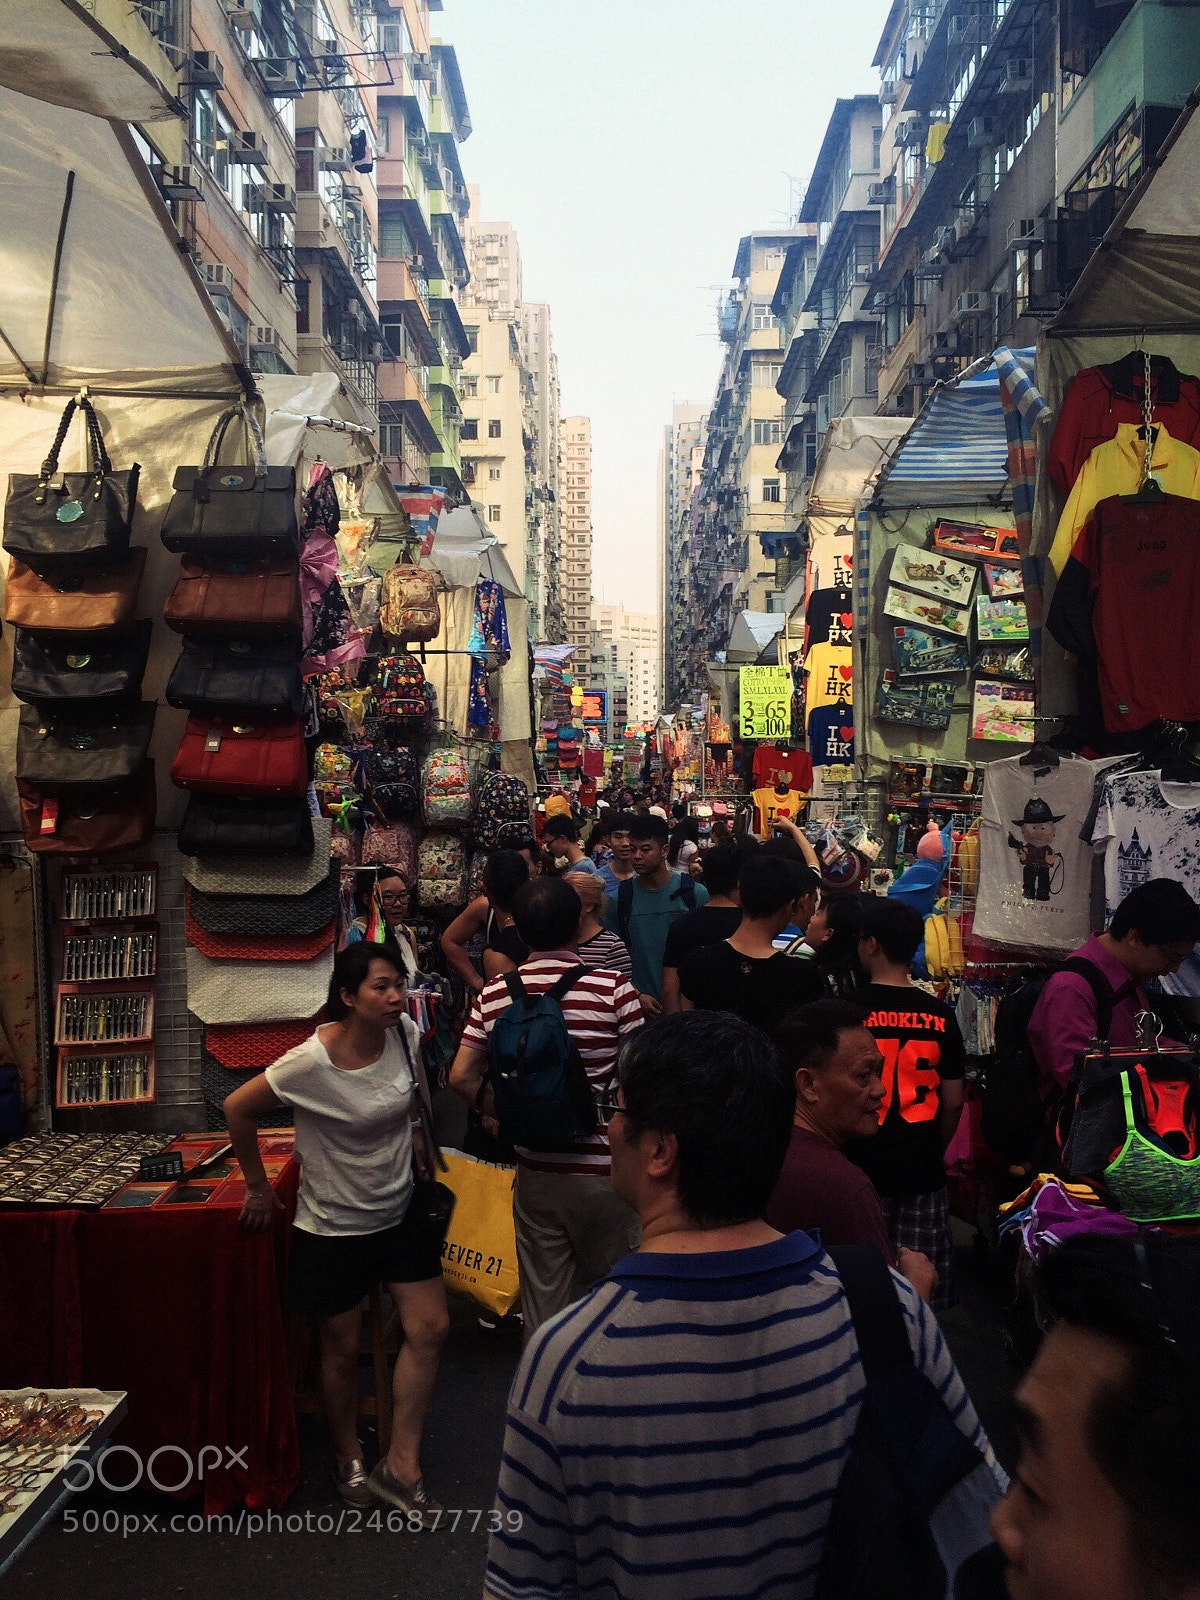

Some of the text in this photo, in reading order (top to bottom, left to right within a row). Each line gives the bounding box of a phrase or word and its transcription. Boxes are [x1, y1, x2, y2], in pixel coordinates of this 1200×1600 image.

[833, 555, 842, 570] I
[830, 612, 841, 629] I
[828, 665, 838, 680] I
[825, 682, 851, 697] HK
[742, 700, 755, 719] 3
[765, 700, 787, 719] 65
[743, 718, 754, 737] 5
[765, 718, 785, 736] 100
[827, 725, 838, 741] I
[825, 741, 851, 757] HK
[862, 1011, 946, 1032] ROOKLYN
[485, 1256, 503, 1277] 21
